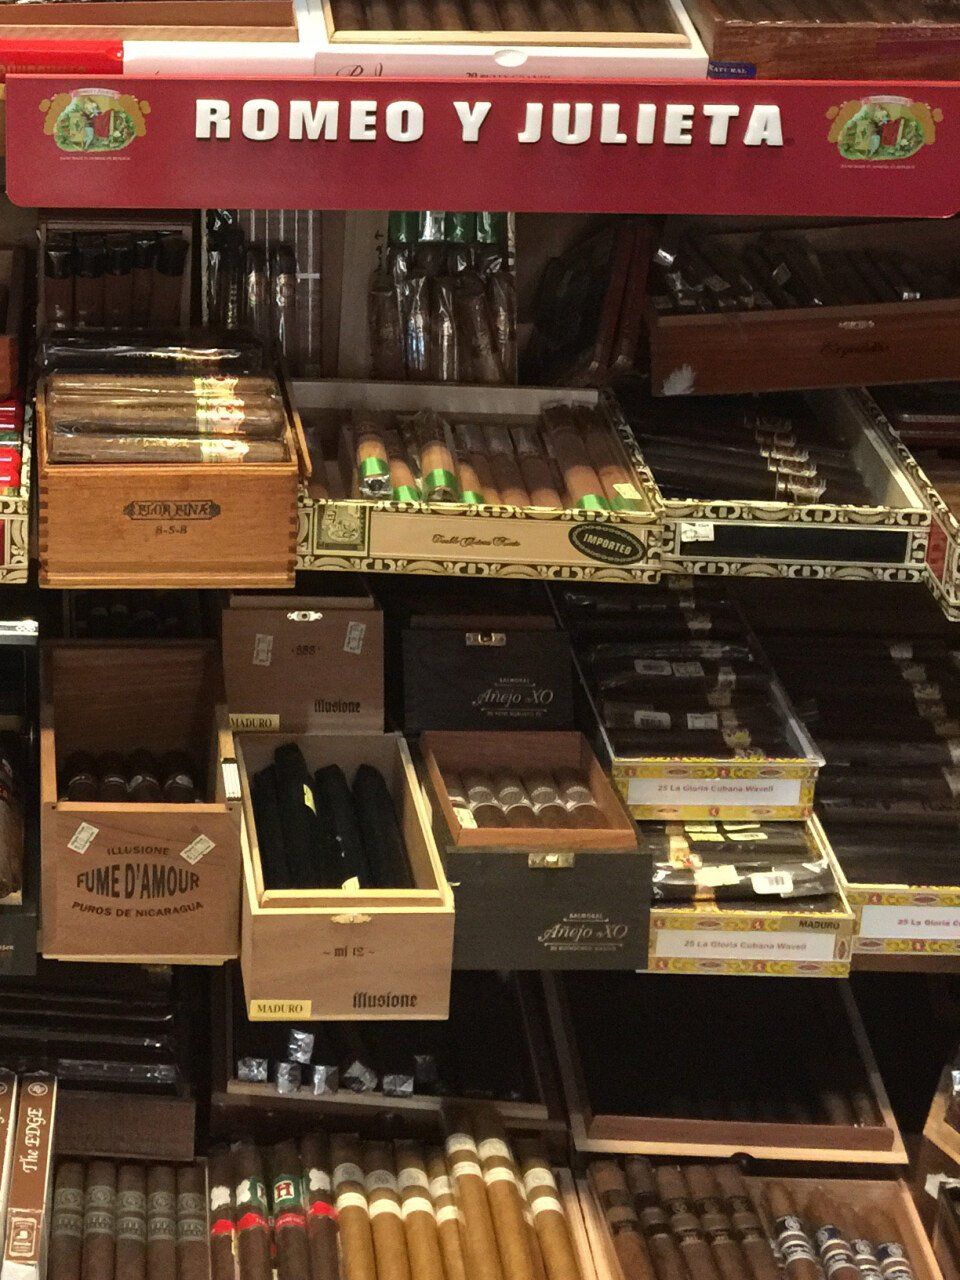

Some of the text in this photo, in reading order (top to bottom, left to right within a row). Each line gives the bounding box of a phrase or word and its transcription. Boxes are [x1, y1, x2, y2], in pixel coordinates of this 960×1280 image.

[195, 98, 784, 147] ROMEO Y JULIETA
[582, 532, 633, 556] IMPORTED
[230, 717, 273, 728] MADURO
[106, 846, 171, 856] ILLUSIONE
[76, 863, 200, 899] FUME D'AMOUR
[71, 901, 204, 918] PUROS DE NICARAGUA
[799, 920, 841, 930] MADURO
[257, 1003, 303, 1014] MADURO
[352, 992, 418, 1009] illusione
[19, 1107, 46, 1173] The EDGE
